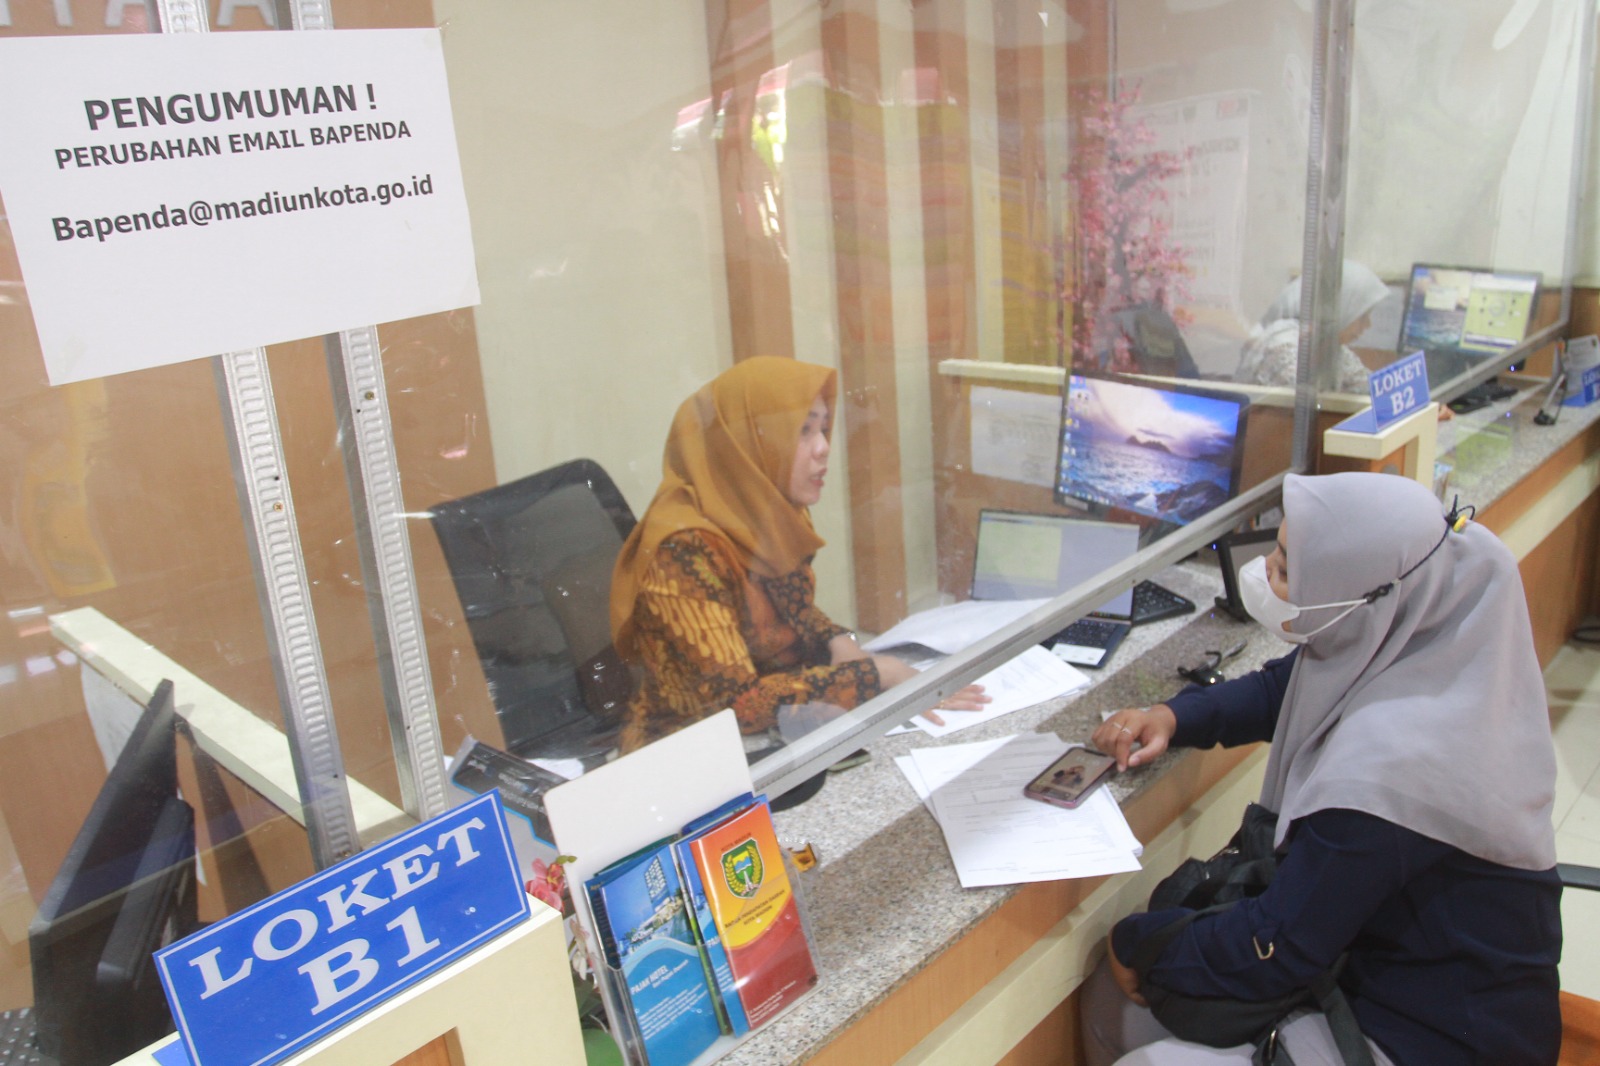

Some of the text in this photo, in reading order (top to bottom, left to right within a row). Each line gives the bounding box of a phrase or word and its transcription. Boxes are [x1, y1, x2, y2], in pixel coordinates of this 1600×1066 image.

[84, 83, 378, 130] PENGUMUMAN !
[54, 120, 412, 170] PERUBAHAN EMAIL BAPENDA
[51, 174, 434, 242] Bapenda@madiunkota.go.id
[1372, 359, 1423, 398] LOKET
[1390, 386, 1416, 417] B2
[188, 816, 487, 1000] LOKET
[297, 905, 441, 1017] B1
